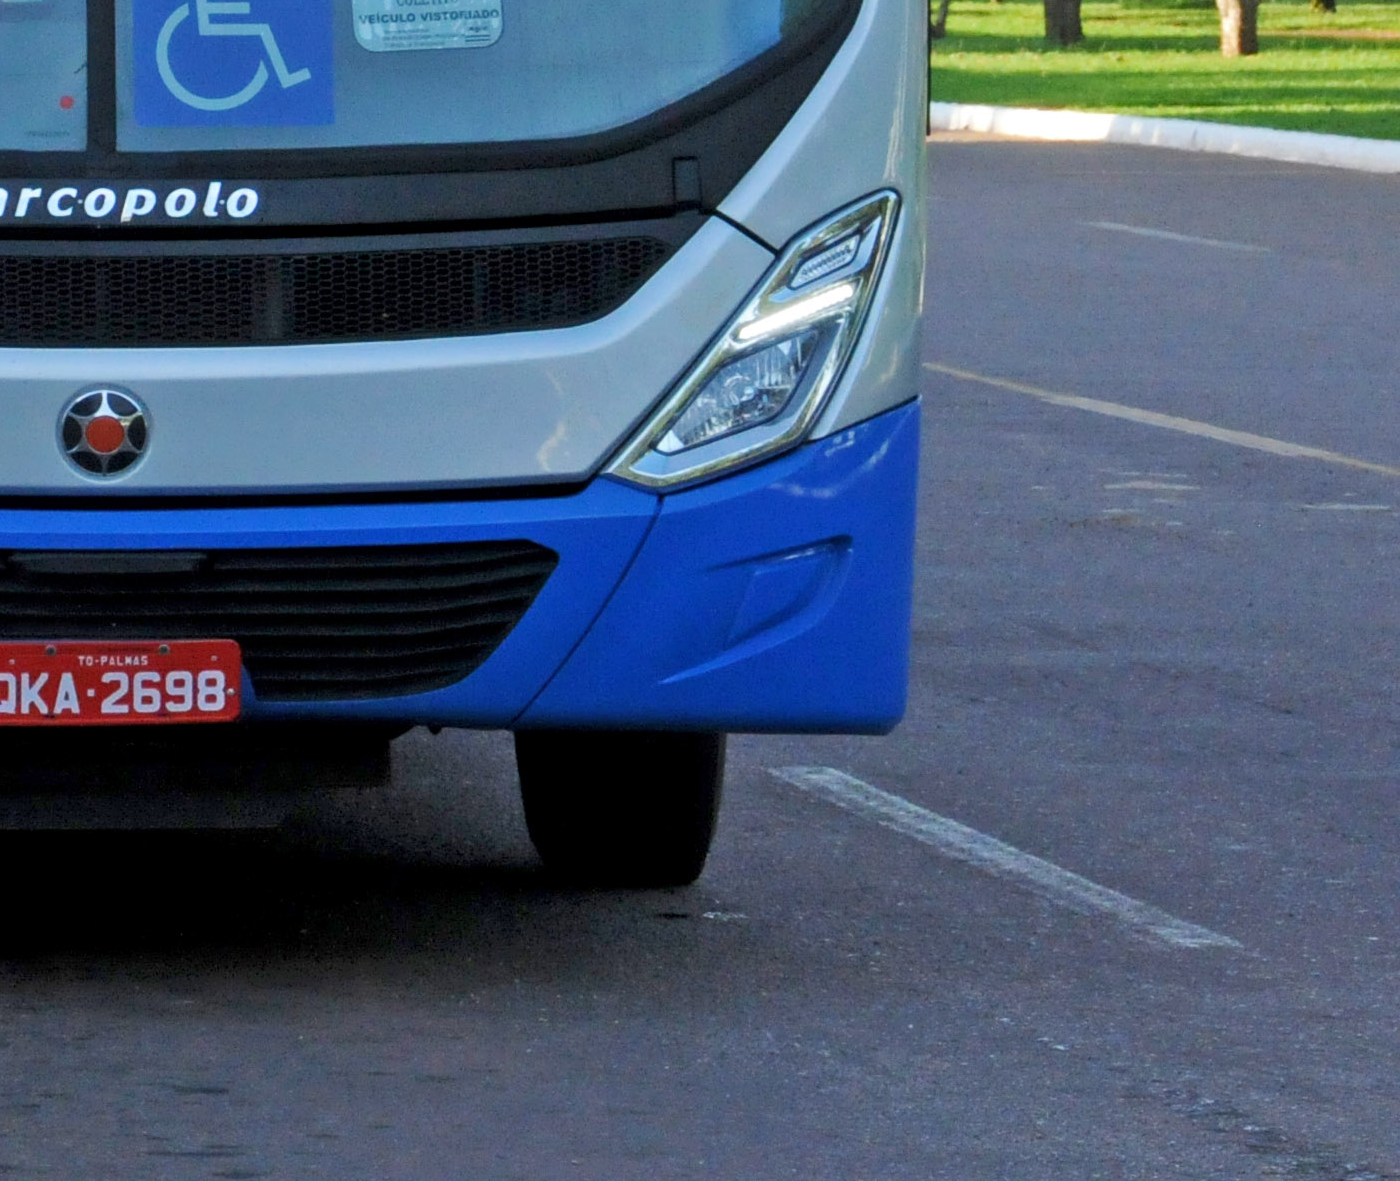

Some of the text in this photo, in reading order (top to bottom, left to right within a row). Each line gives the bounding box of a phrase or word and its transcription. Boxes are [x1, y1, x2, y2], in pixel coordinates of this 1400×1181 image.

[359, 9, 500, 24] VEÍCULO VISTORIADO
[77, 655, 149, 667] TO-PALMAS
